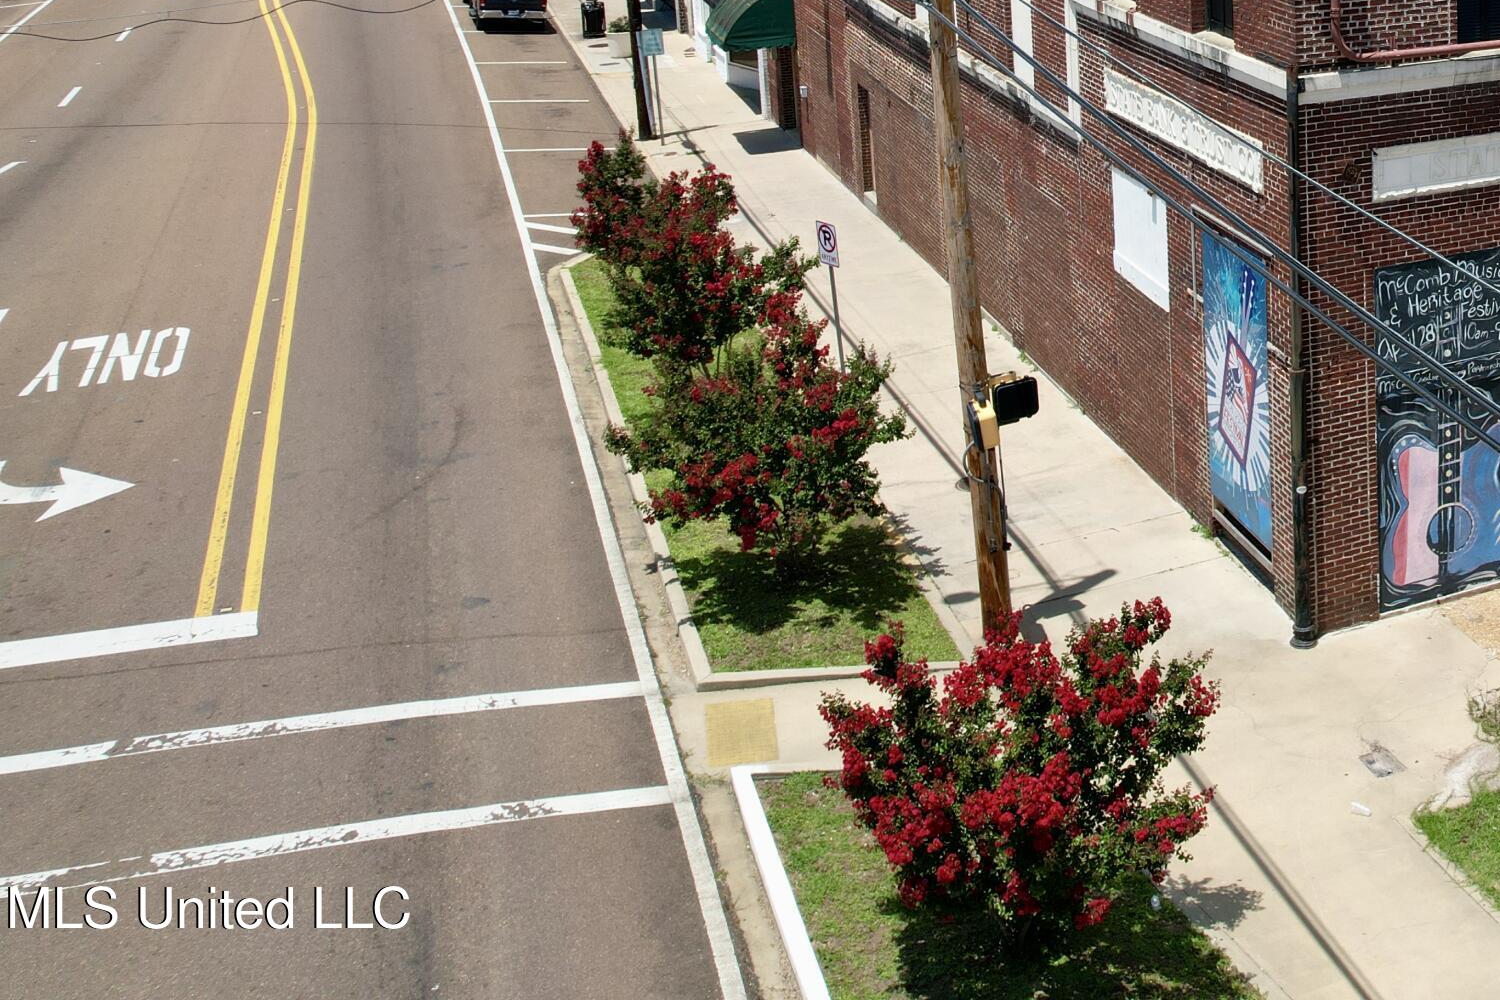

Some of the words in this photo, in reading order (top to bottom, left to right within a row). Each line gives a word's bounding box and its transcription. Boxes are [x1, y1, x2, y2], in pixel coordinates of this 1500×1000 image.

[1110, 83, 1144, 121] STATE
[1144, 100, 1177, 139] BANK
[1192, 121, 1233, 168] TRUST
[1378, 266, 1451, 306] McComb
[1407, 282, 1483, 317] Heritage
[1417, 322, 1437, 346] 28
[18, 326, 191, 397] ONLY
